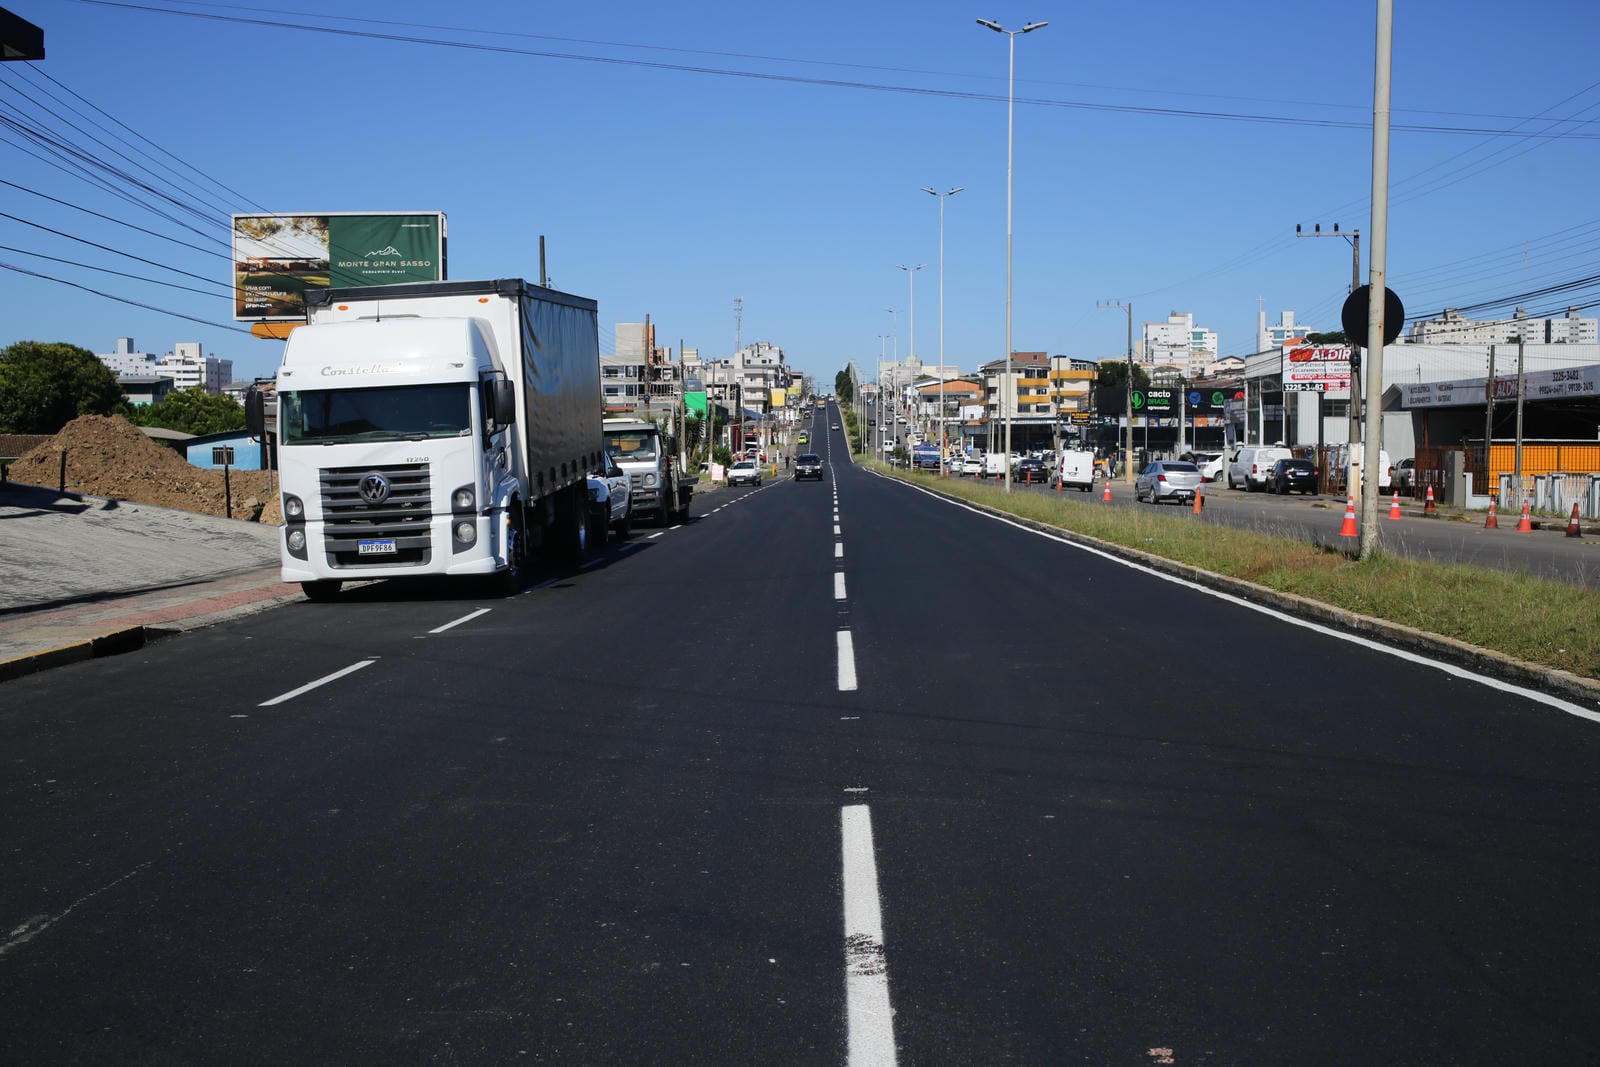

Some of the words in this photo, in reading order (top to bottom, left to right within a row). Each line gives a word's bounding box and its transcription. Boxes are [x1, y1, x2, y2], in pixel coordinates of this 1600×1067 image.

[1311, 349, 1351, 360] ALDIR
[321, 364, 400, 376] Constella
[1148, 390, 1171, 398] cacto
[362, 543, 393, 552] DPF9F86
